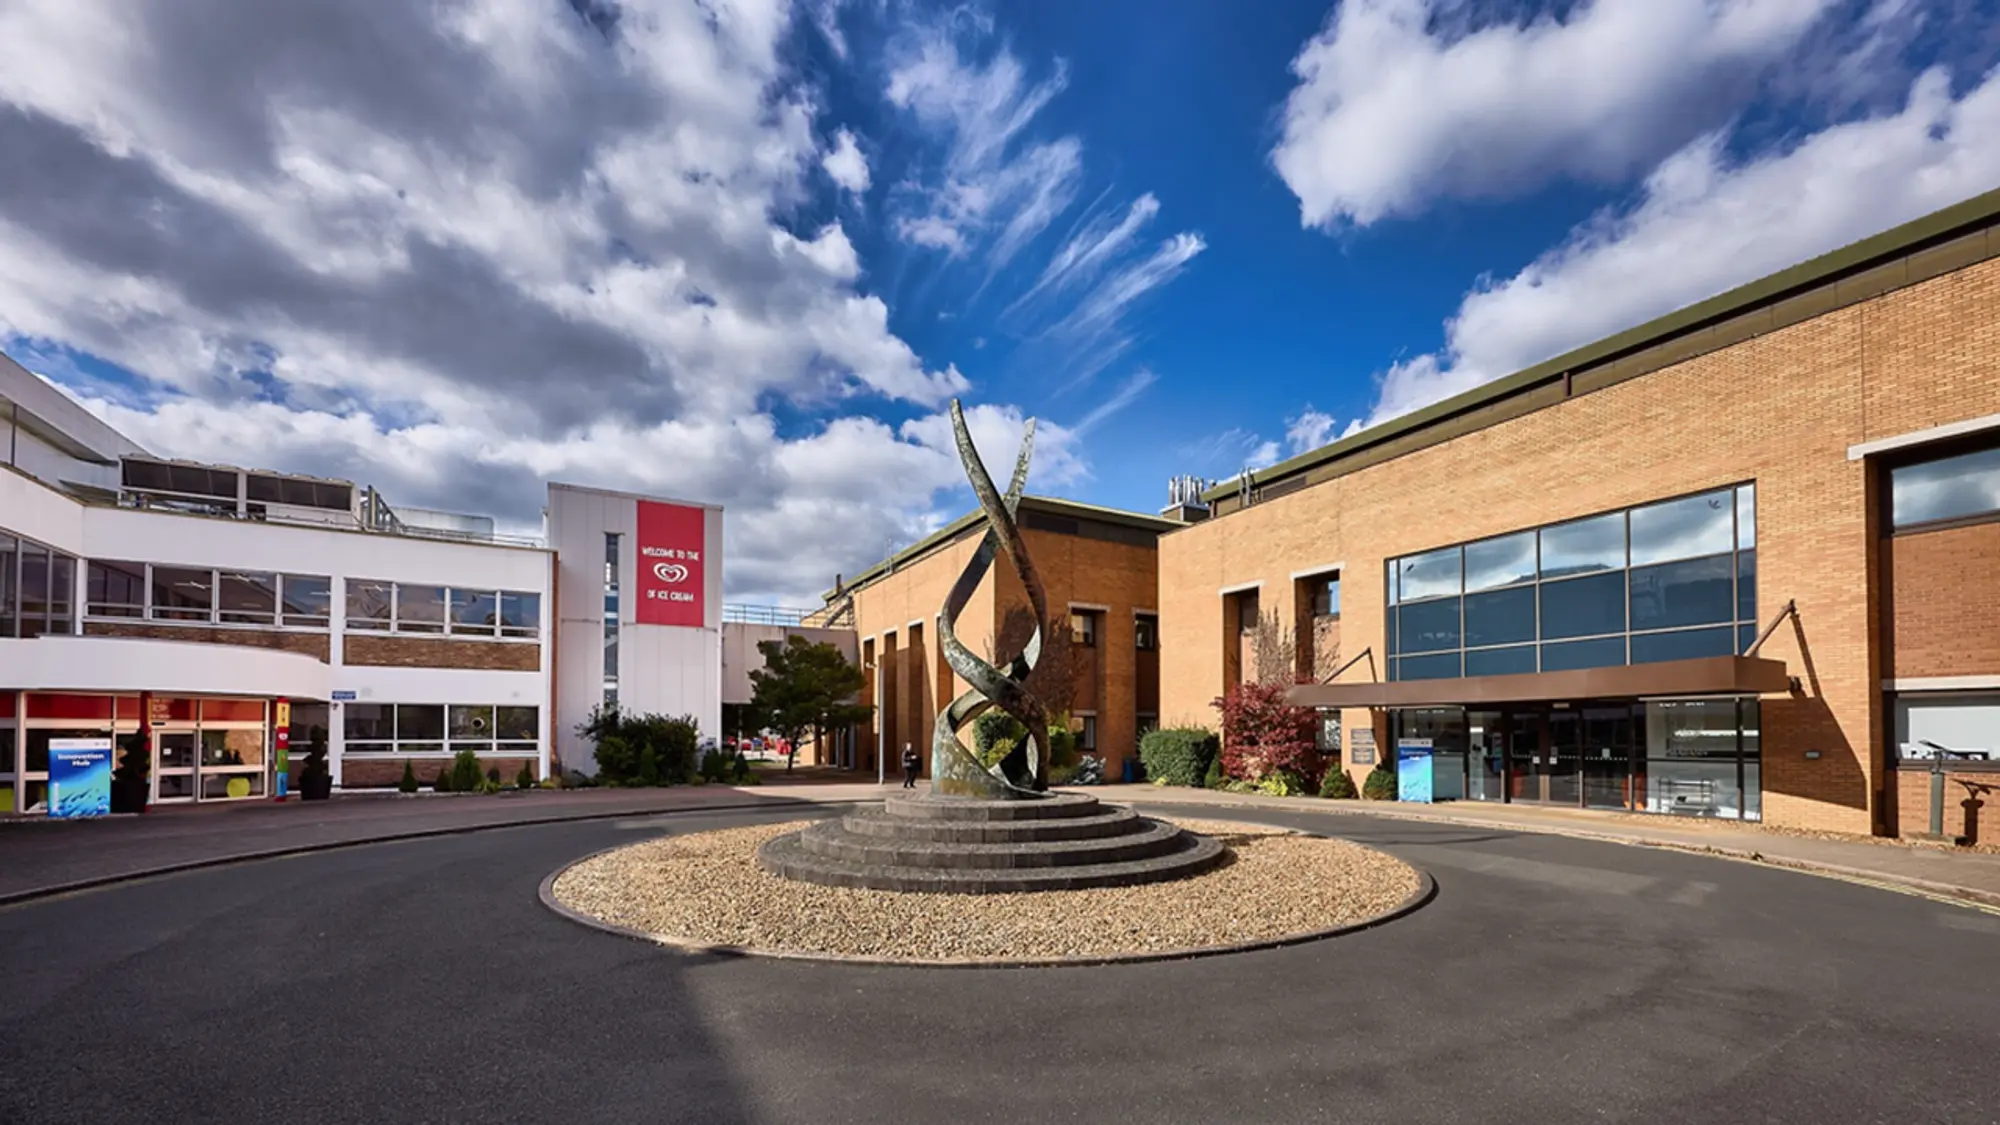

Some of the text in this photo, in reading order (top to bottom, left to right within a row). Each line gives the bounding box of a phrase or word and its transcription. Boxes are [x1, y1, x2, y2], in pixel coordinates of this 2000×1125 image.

[642, 546, 699, 561] WELCOME TO THE
[647, 588, 694, 602] OF ICE CREAM
